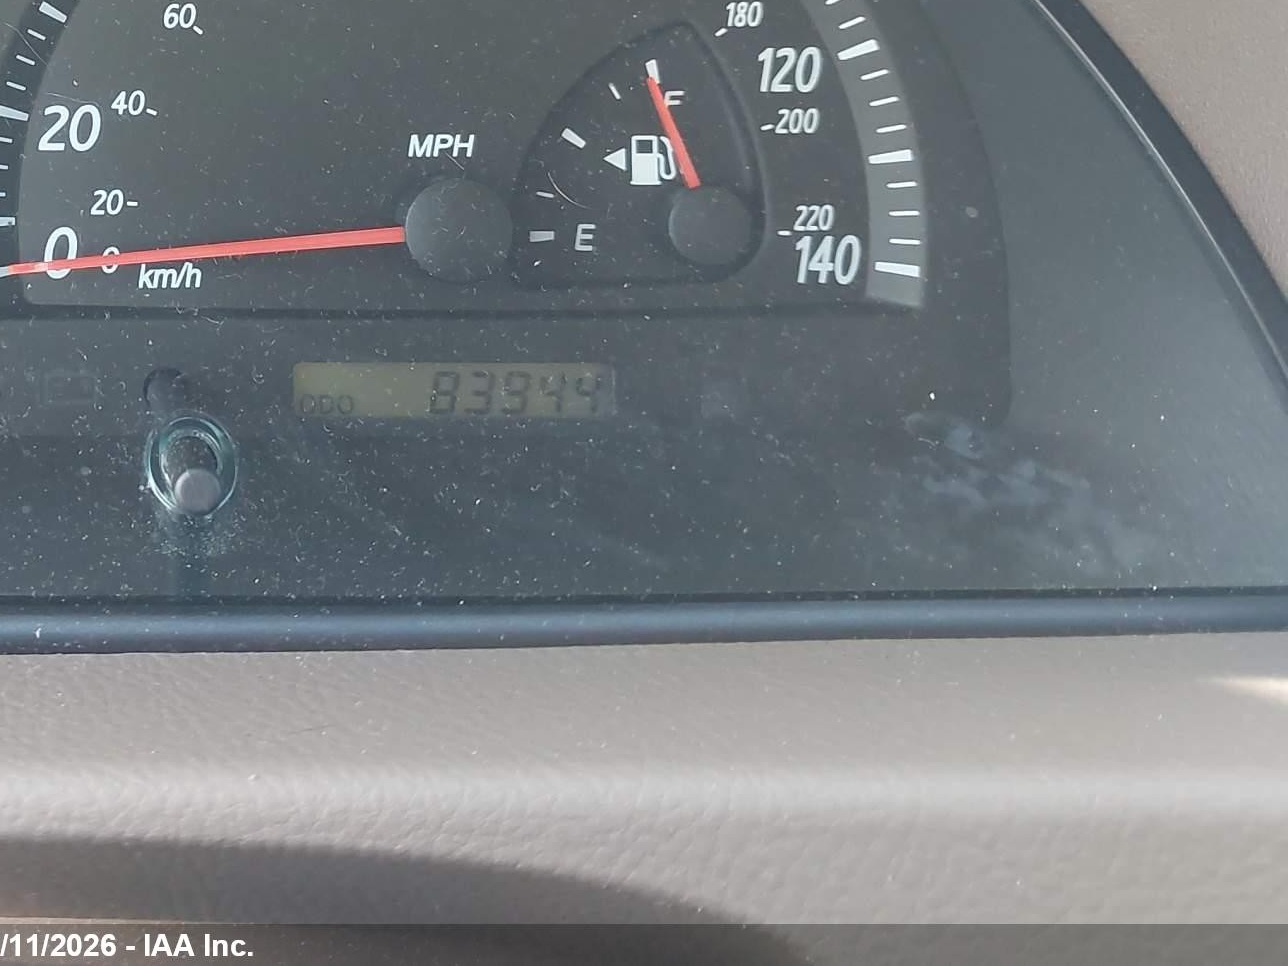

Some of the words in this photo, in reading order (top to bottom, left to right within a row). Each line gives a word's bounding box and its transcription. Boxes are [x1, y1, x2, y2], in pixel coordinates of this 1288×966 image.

[162, 3, 197, 30] 60
[726, 1, 763, 28] 180
[757, 47, 822, 93] 120
[111, 89, 146, 115] 40
[662, 90, 685, 111] F
[38, 104, 102, 152] 20
[774, 109, 819, 134] 200
[408, 134, 474, 158] MPH
[90, 190, 123, 216] 20
[794, 205, 834, 232] 220
[574, 224, 596, 251] E
[43, 226, 78, 279] 0
[794, 235, 860, 285] 140
[138, 262, 202, 290] km/h
